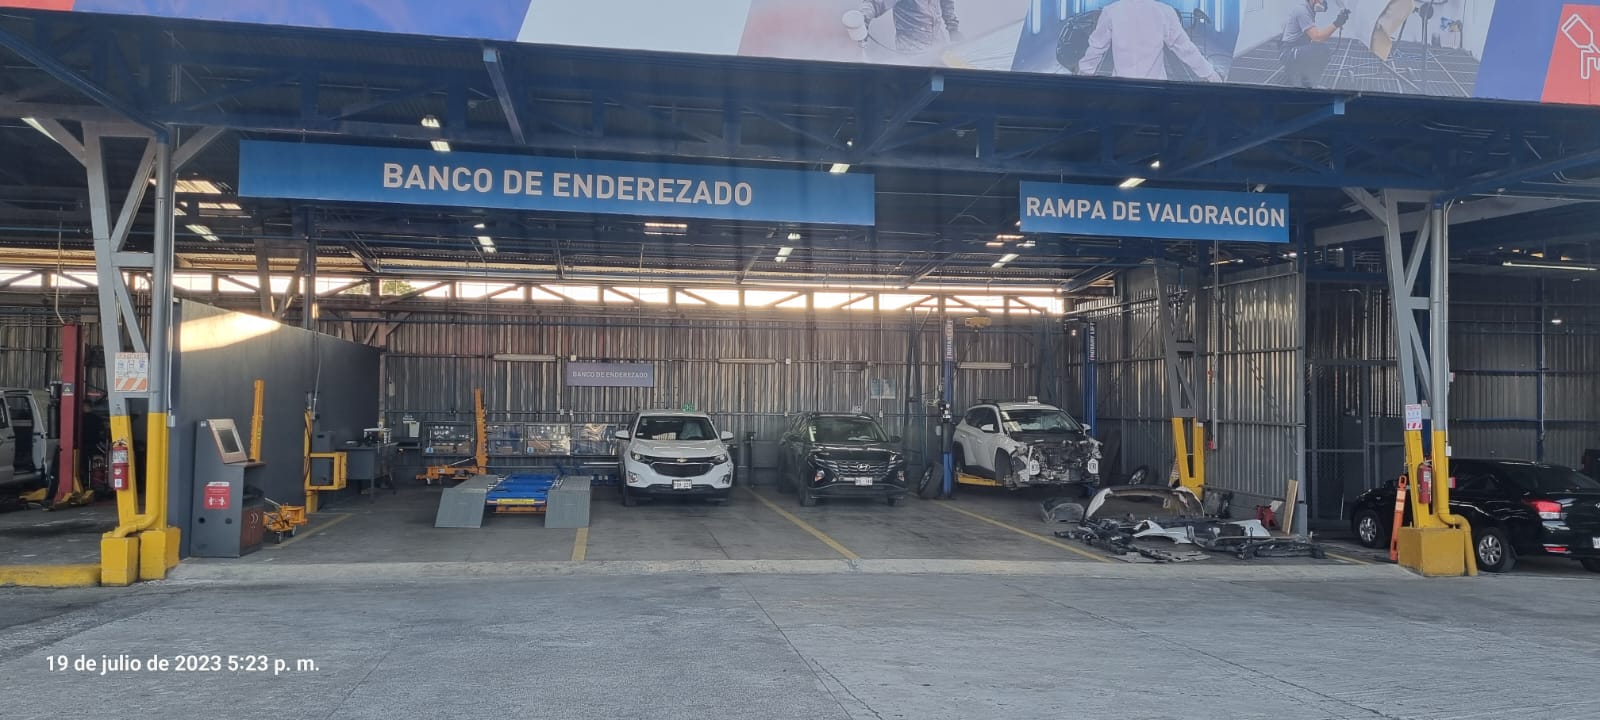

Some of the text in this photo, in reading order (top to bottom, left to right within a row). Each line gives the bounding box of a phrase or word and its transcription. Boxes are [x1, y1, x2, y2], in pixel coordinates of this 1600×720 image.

[383, 162, 752, 207] BANCO DE ENDEREZADO
[1026, 196, 1285, 228] RAMPA DE VALORACIÓN
